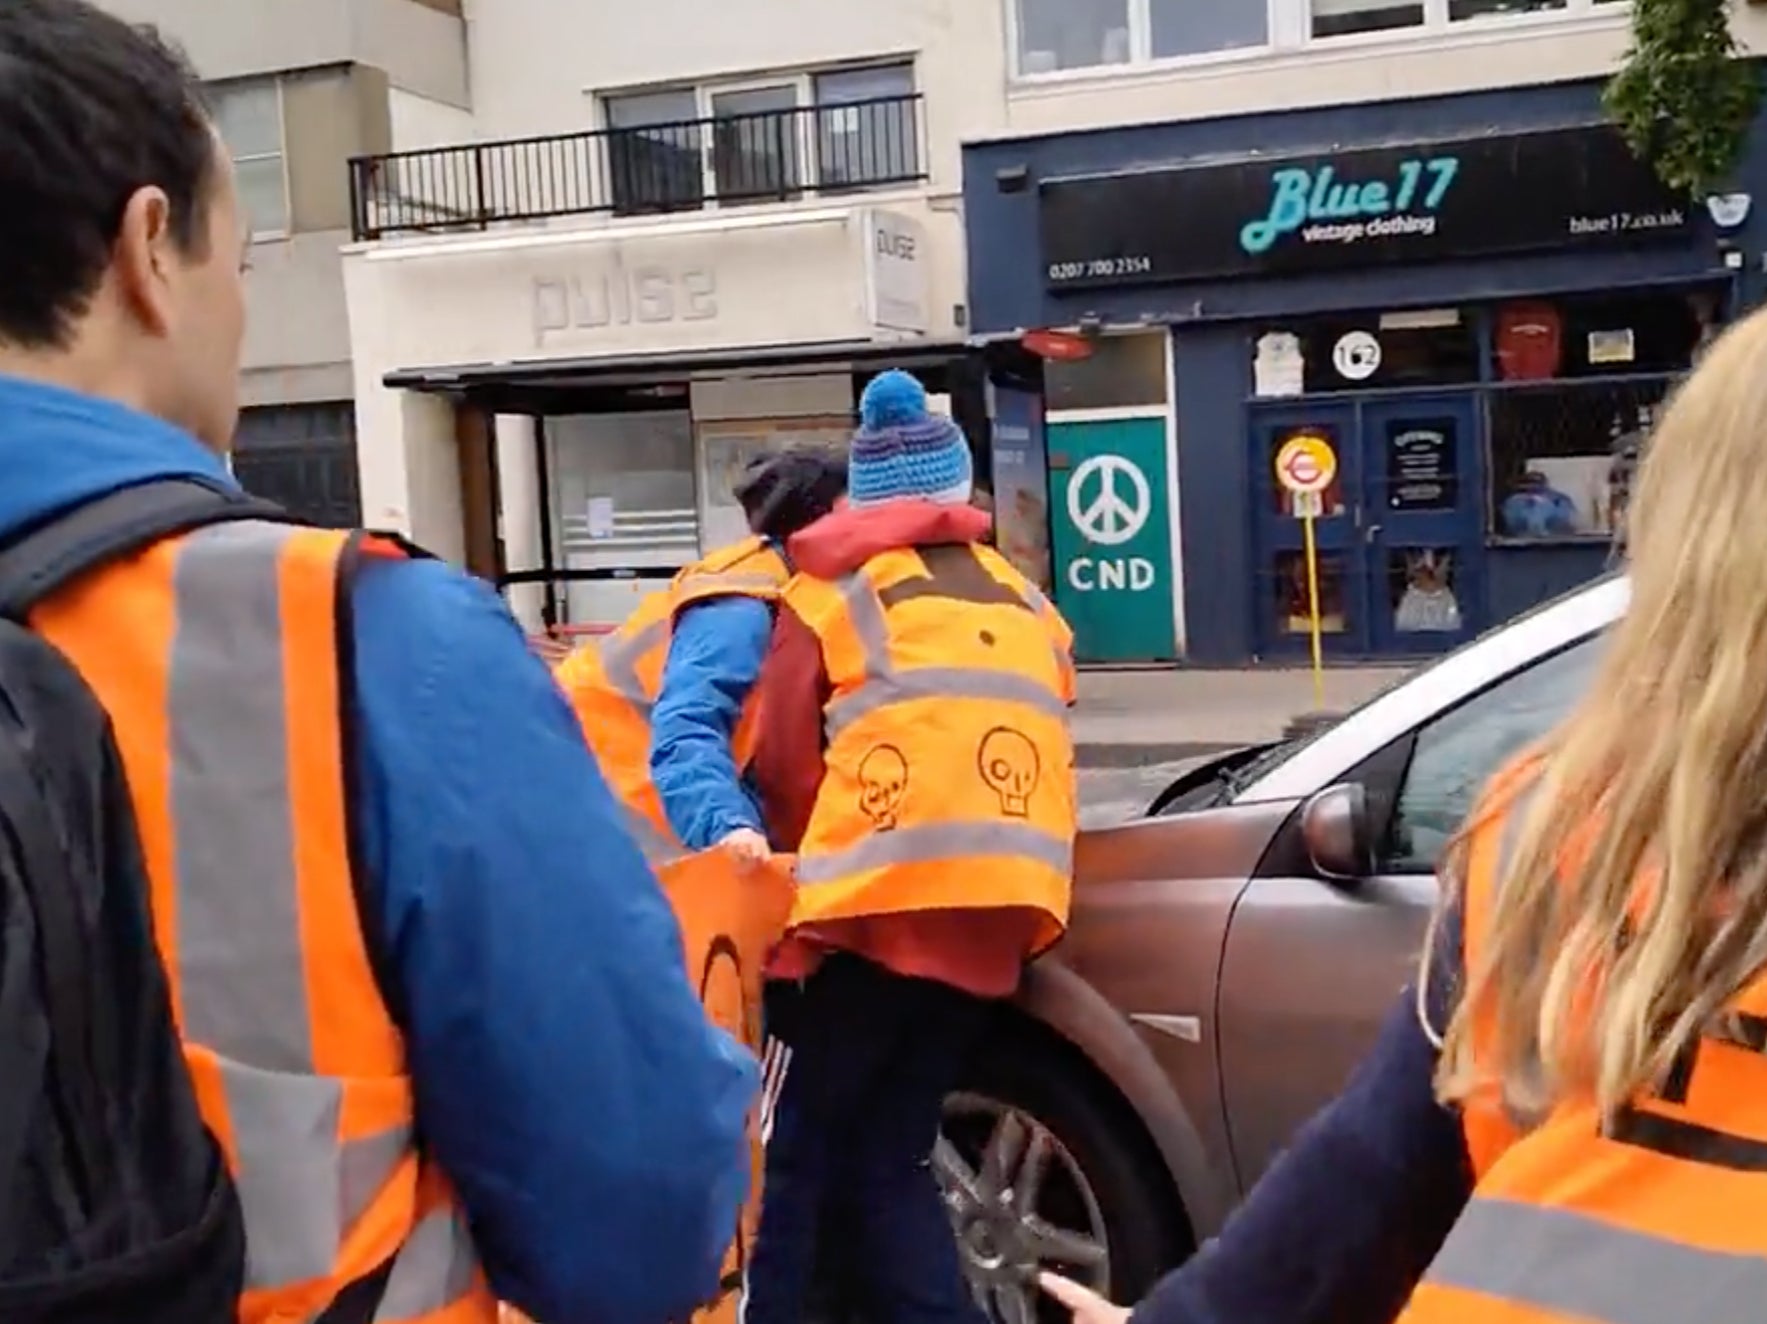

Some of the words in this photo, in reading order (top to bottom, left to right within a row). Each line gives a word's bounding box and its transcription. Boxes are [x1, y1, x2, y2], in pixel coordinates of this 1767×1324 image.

[1302, 221, 1364, 243] vintage
[1366, 214, 1435, 237] clothing
[1569, 209, 1684, 234] blue17.co.uk
[1049, 261, 1084, 280] 0207
[1087, 259, 1114, 277] 700
[533, 251, 718, 348] pulse
[1068, 557, 1155, 592] CND
